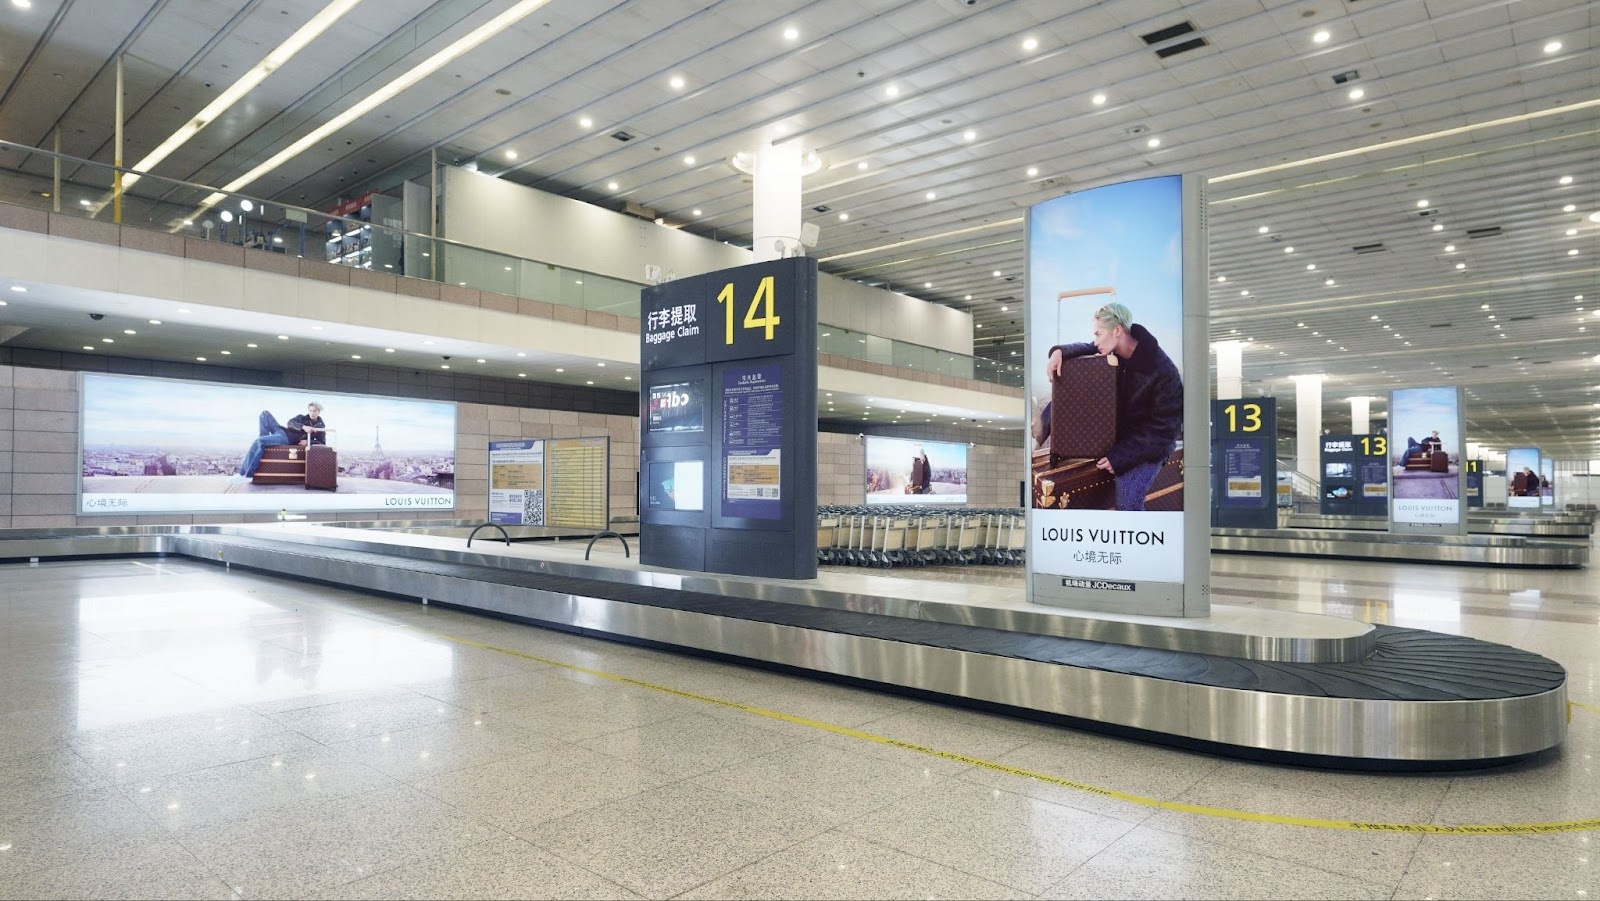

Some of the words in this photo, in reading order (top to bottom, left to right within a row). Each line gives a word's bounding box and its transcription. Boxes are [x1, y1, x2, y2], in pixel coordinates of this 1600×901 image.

[648, 304, 697, 331] 行李提取
[717, 276, 781, 345] 14
[645, 330, 676, 345] Baggage
[677, 324, 700, 338] Claim
[1224, 403, 1262, 433] 13
[1360, 436, 1387, 456] 13
[86, 498, 129, 508] 心境无际
[385, 497, 412, 506] LOUIS
[415, 497, 452, 506] VUITTON
[1042, 527, 1084, 543] LOUIS
[1088, 528, 1165, 546] VUITTON
[1073, 550, 1123, 565] 心境无际
[1092, 581, 1132, 591] JCDecaux
[976, 760, 1010, 772] trolley
[1013, 769, 1061, 784] beyond
[1061, 780, 1085, 790] this
[1086, 785, 1112, 796] line
